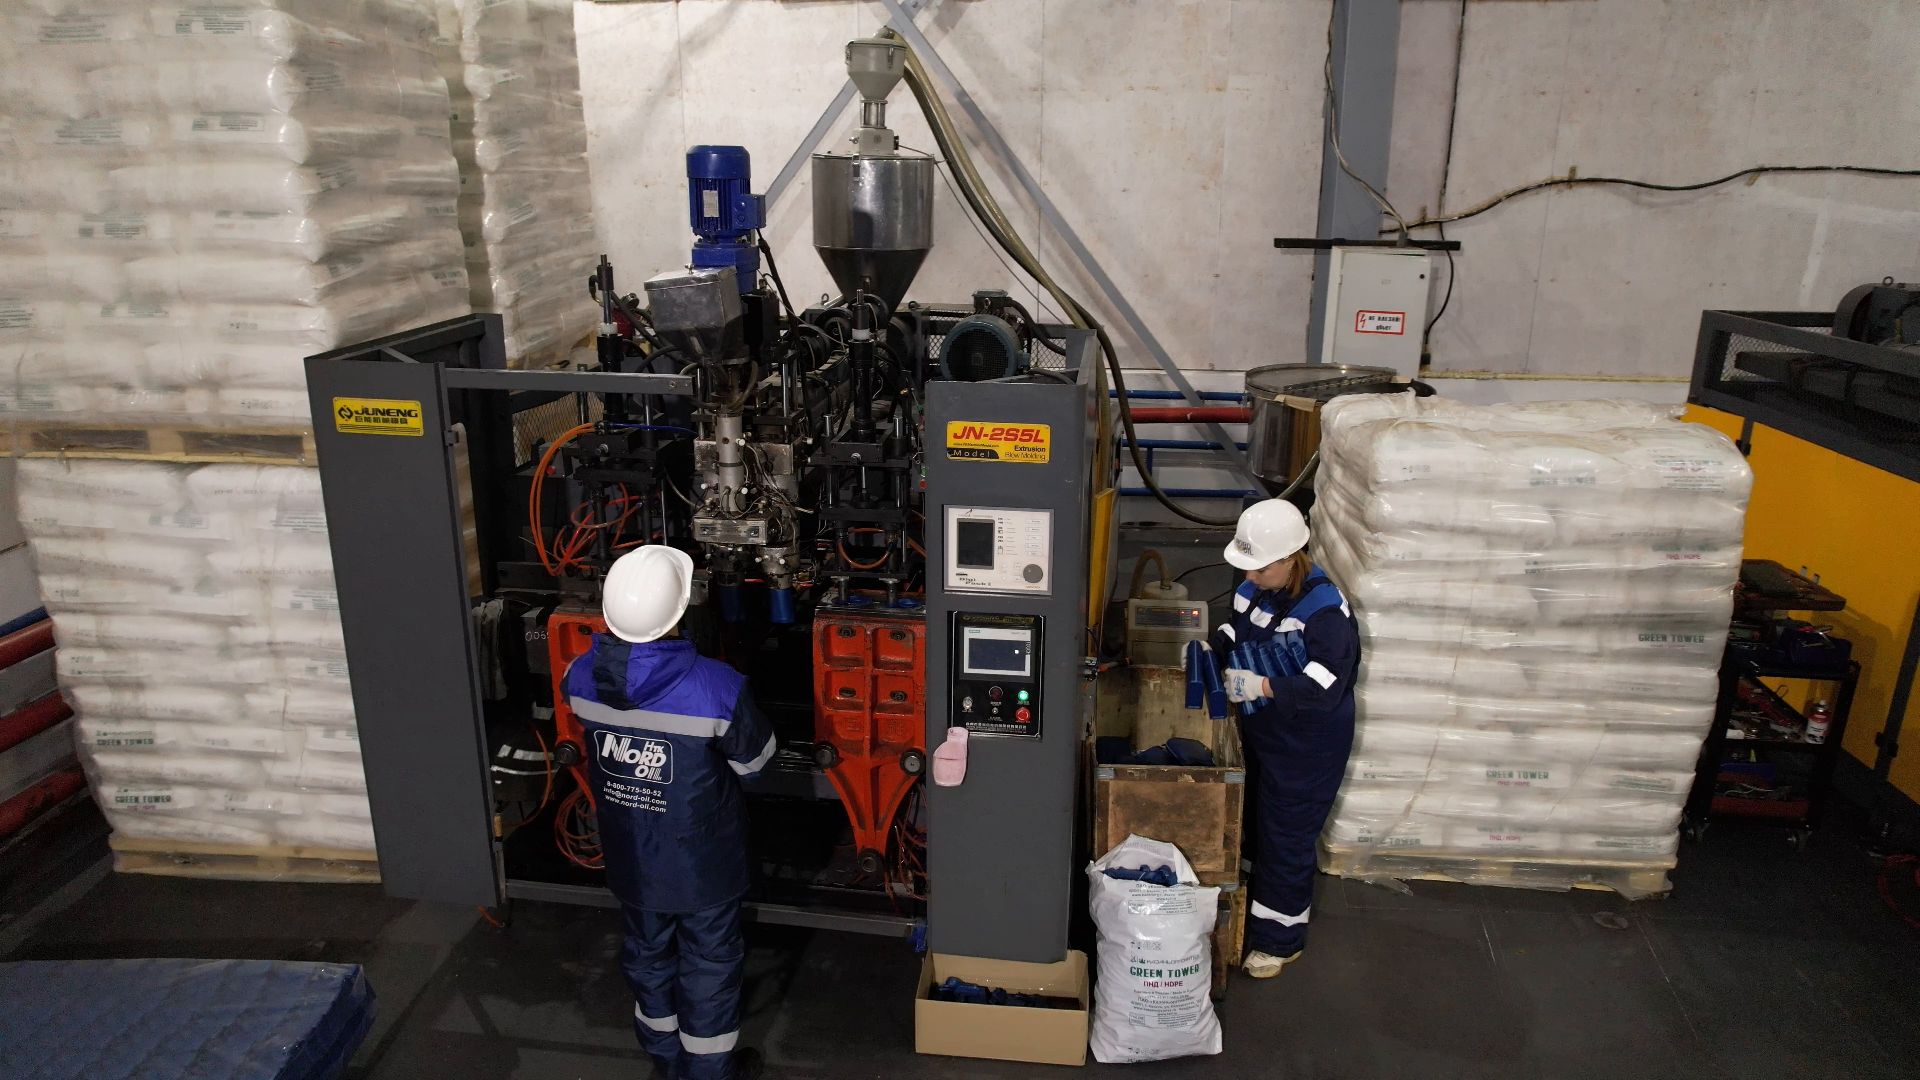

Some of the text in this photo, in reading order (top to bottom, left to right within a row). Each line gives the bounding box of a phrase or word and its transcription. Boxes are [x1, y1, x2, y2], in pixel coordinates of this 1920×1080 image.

[354, 407, 418, 418] JUNENG
[953, 426, 1045, 443] JN-2S5L
[953, 449, 990, 458] Model
[1014, 444, 1046, 453] Extrusion
[1638, 633, 1705, 643] GREEN TOWER
[607, 781, 662, 797] 8-800-775-50-52
[603, 787, 667, 806] info@nord-oil.com
[604, 794, 667, 813] www.nord-oil.com
[1130, 964, 1200, 978] GREEN TOWER
[1143, 980, 1159, 988] ПНД
[1164, 980, 1184, 988] HDPE
